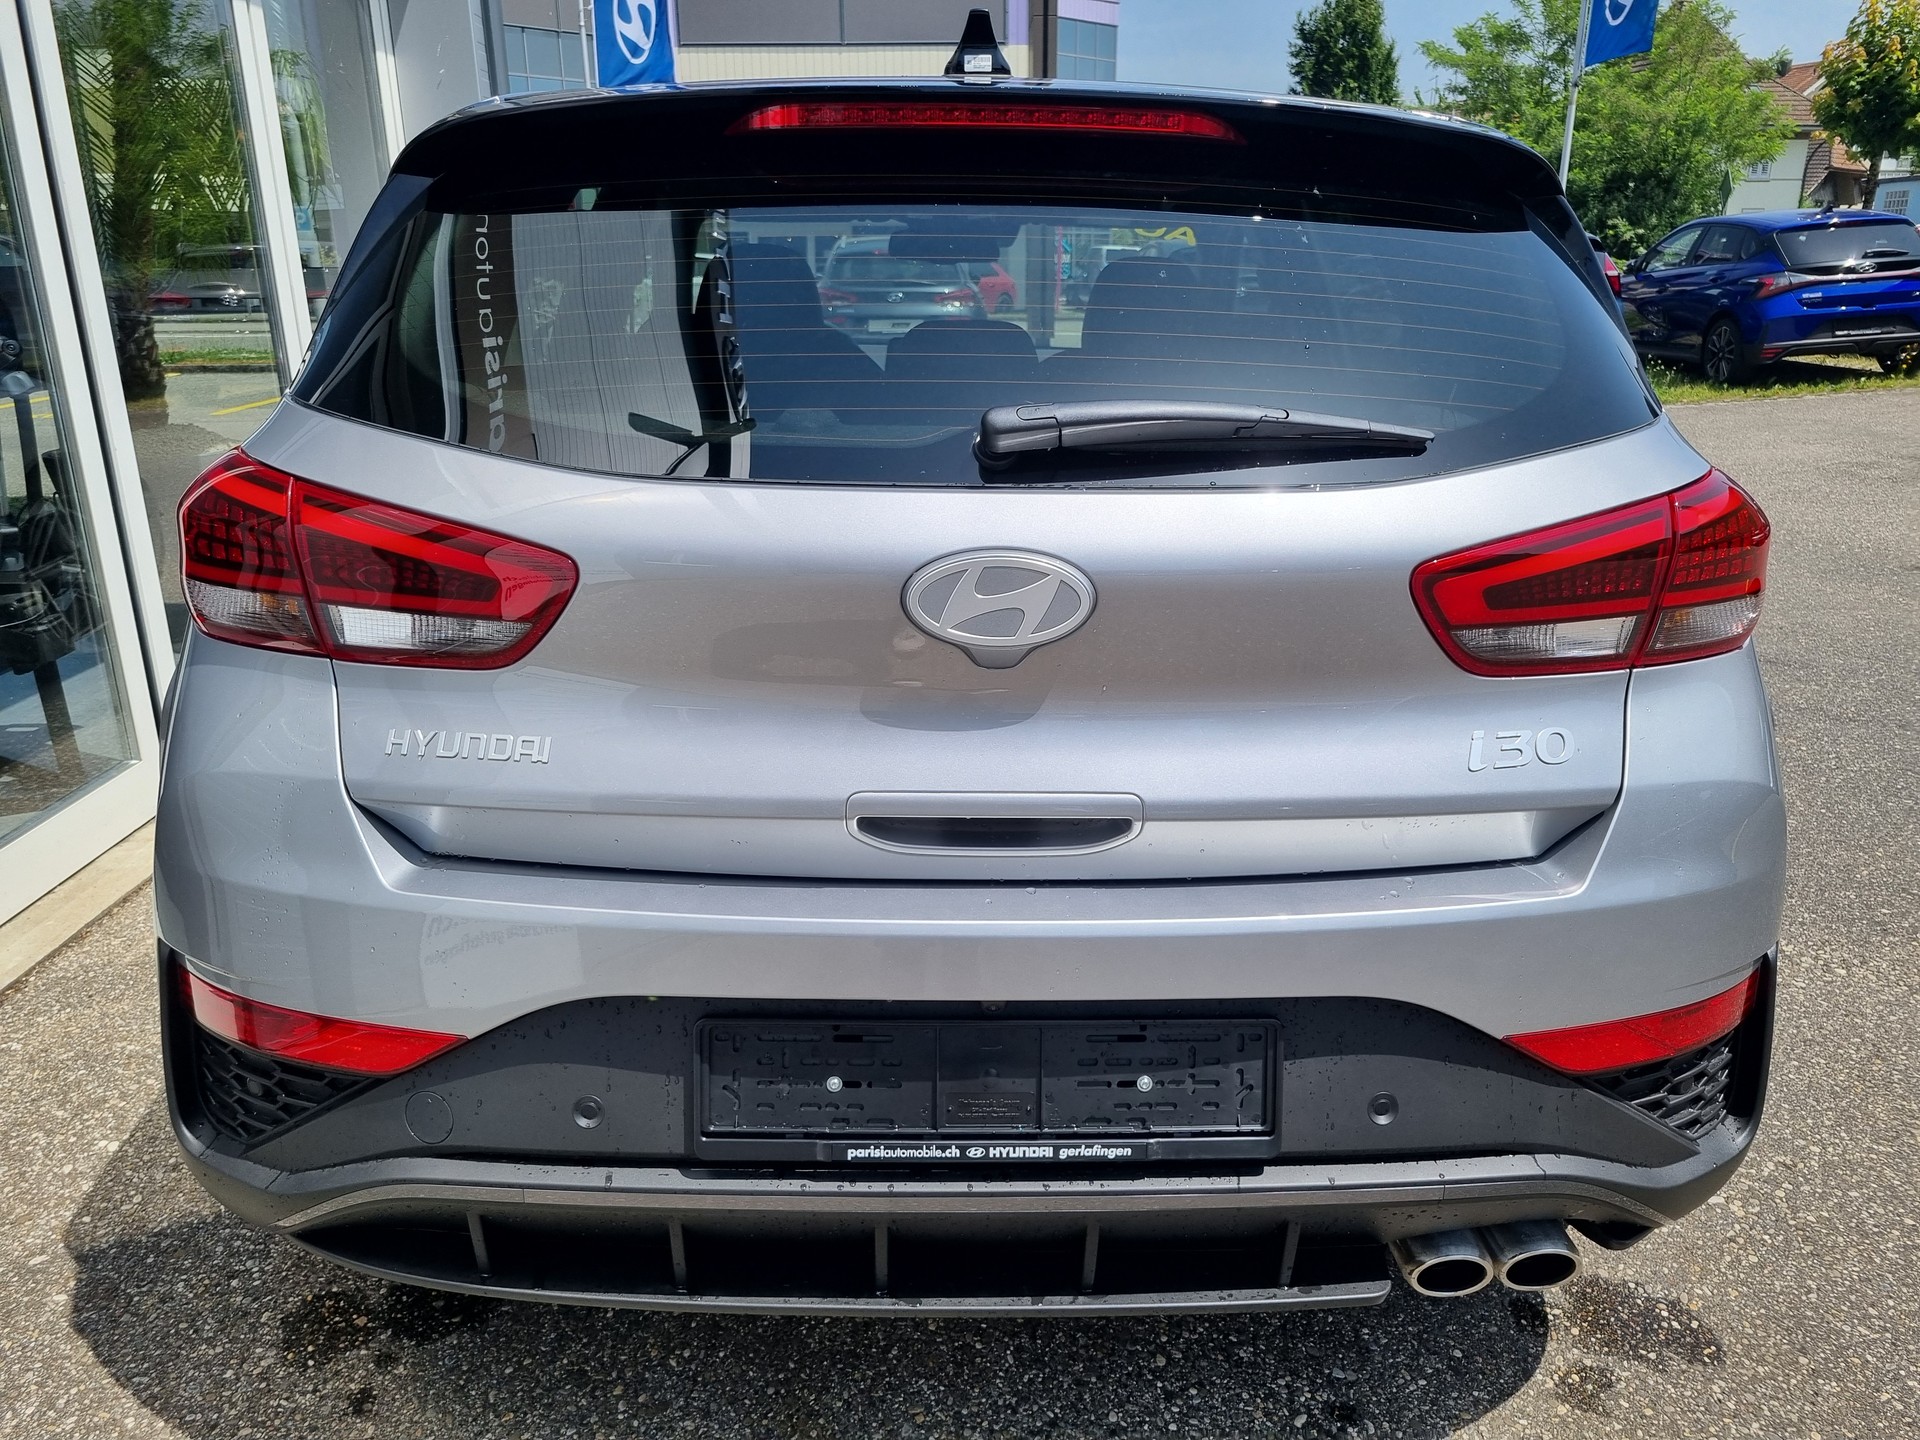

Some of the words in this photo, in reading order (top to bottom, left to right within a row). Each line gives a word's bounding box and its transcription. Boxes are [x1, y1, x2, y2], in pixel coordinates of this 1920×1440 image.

[384, 729, 553, 764] HYUNDAI
[1467, 727, 1576, 773] i30
[847, 1145, 961, 1161] parisiautomobile.ch
[988, 1146, 1054, 1159] HYUNDAI
[1058, 1144, 1133, 1160] gerlafingen
